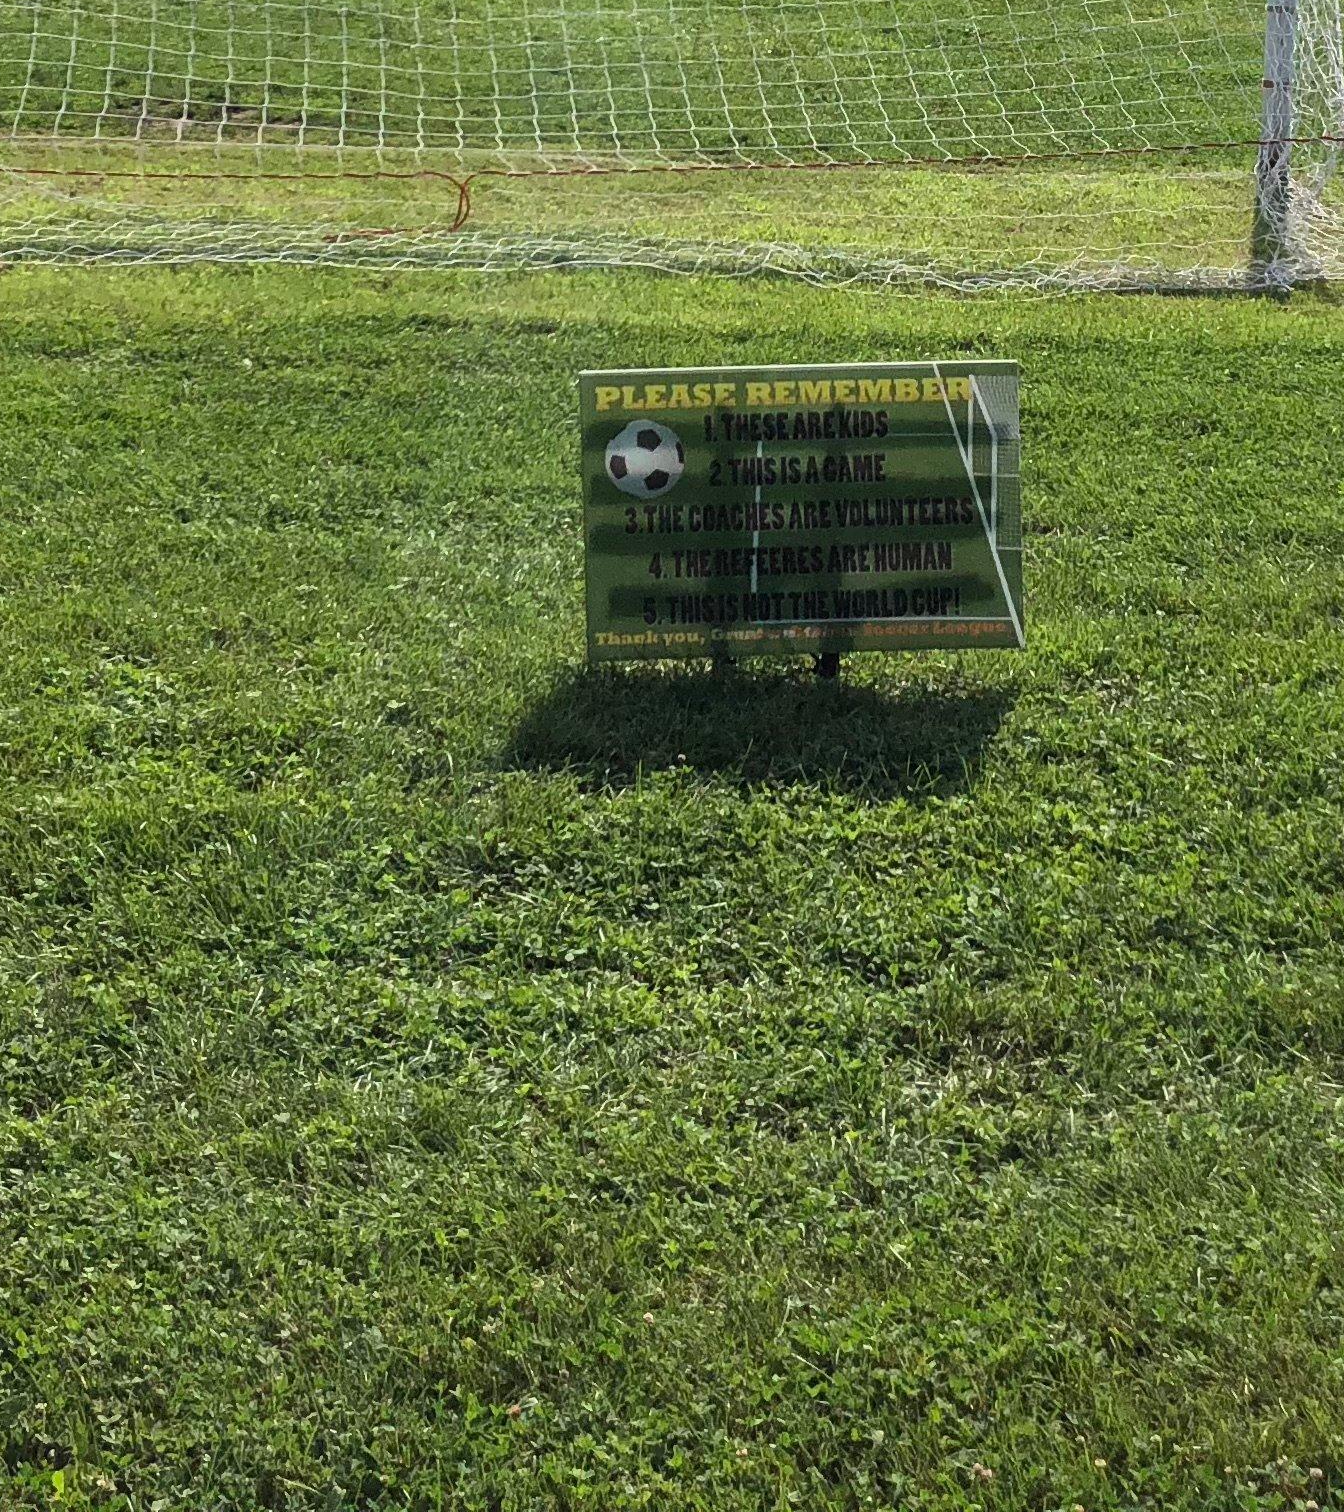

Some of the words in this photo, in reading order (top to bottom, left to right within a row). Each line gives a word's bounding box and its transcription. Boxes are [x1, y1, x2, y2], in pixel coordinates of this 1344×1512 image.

[596, 382, 736, 411] PLEASE
[746, 376, 973, 407] REMEMBER
[721, 411, 789, 442] THESE
[793, 410, 836, 440] ARE
[838, 409, 889, 439] KIDS
[727, 456, 776, 486] THIS
[780, 455, 801, 484] IS
[805, 455, 820, 484] A
[822, 453, 886, 483] GAME
[689, 501, 785, 532] COACHES
[789, 500, 831, 530] ARE
[835, 497, 974, 528] VOLUNTEERS
[674, 549, 711, 578] THE
[828, 543, 870, 574] ARE
[873, 541, 952, 571] HUMAN
[668, 594, 716, 625] THIS
[718, 593, 739, 623] IS
[742, 592, 785, 621] NOT
[788, 591, 830, 620] THE
[833, 589, 907, 618] WORLD
[595, 631, 657, 646] Thank
[663, 632, 705, 647] you,
